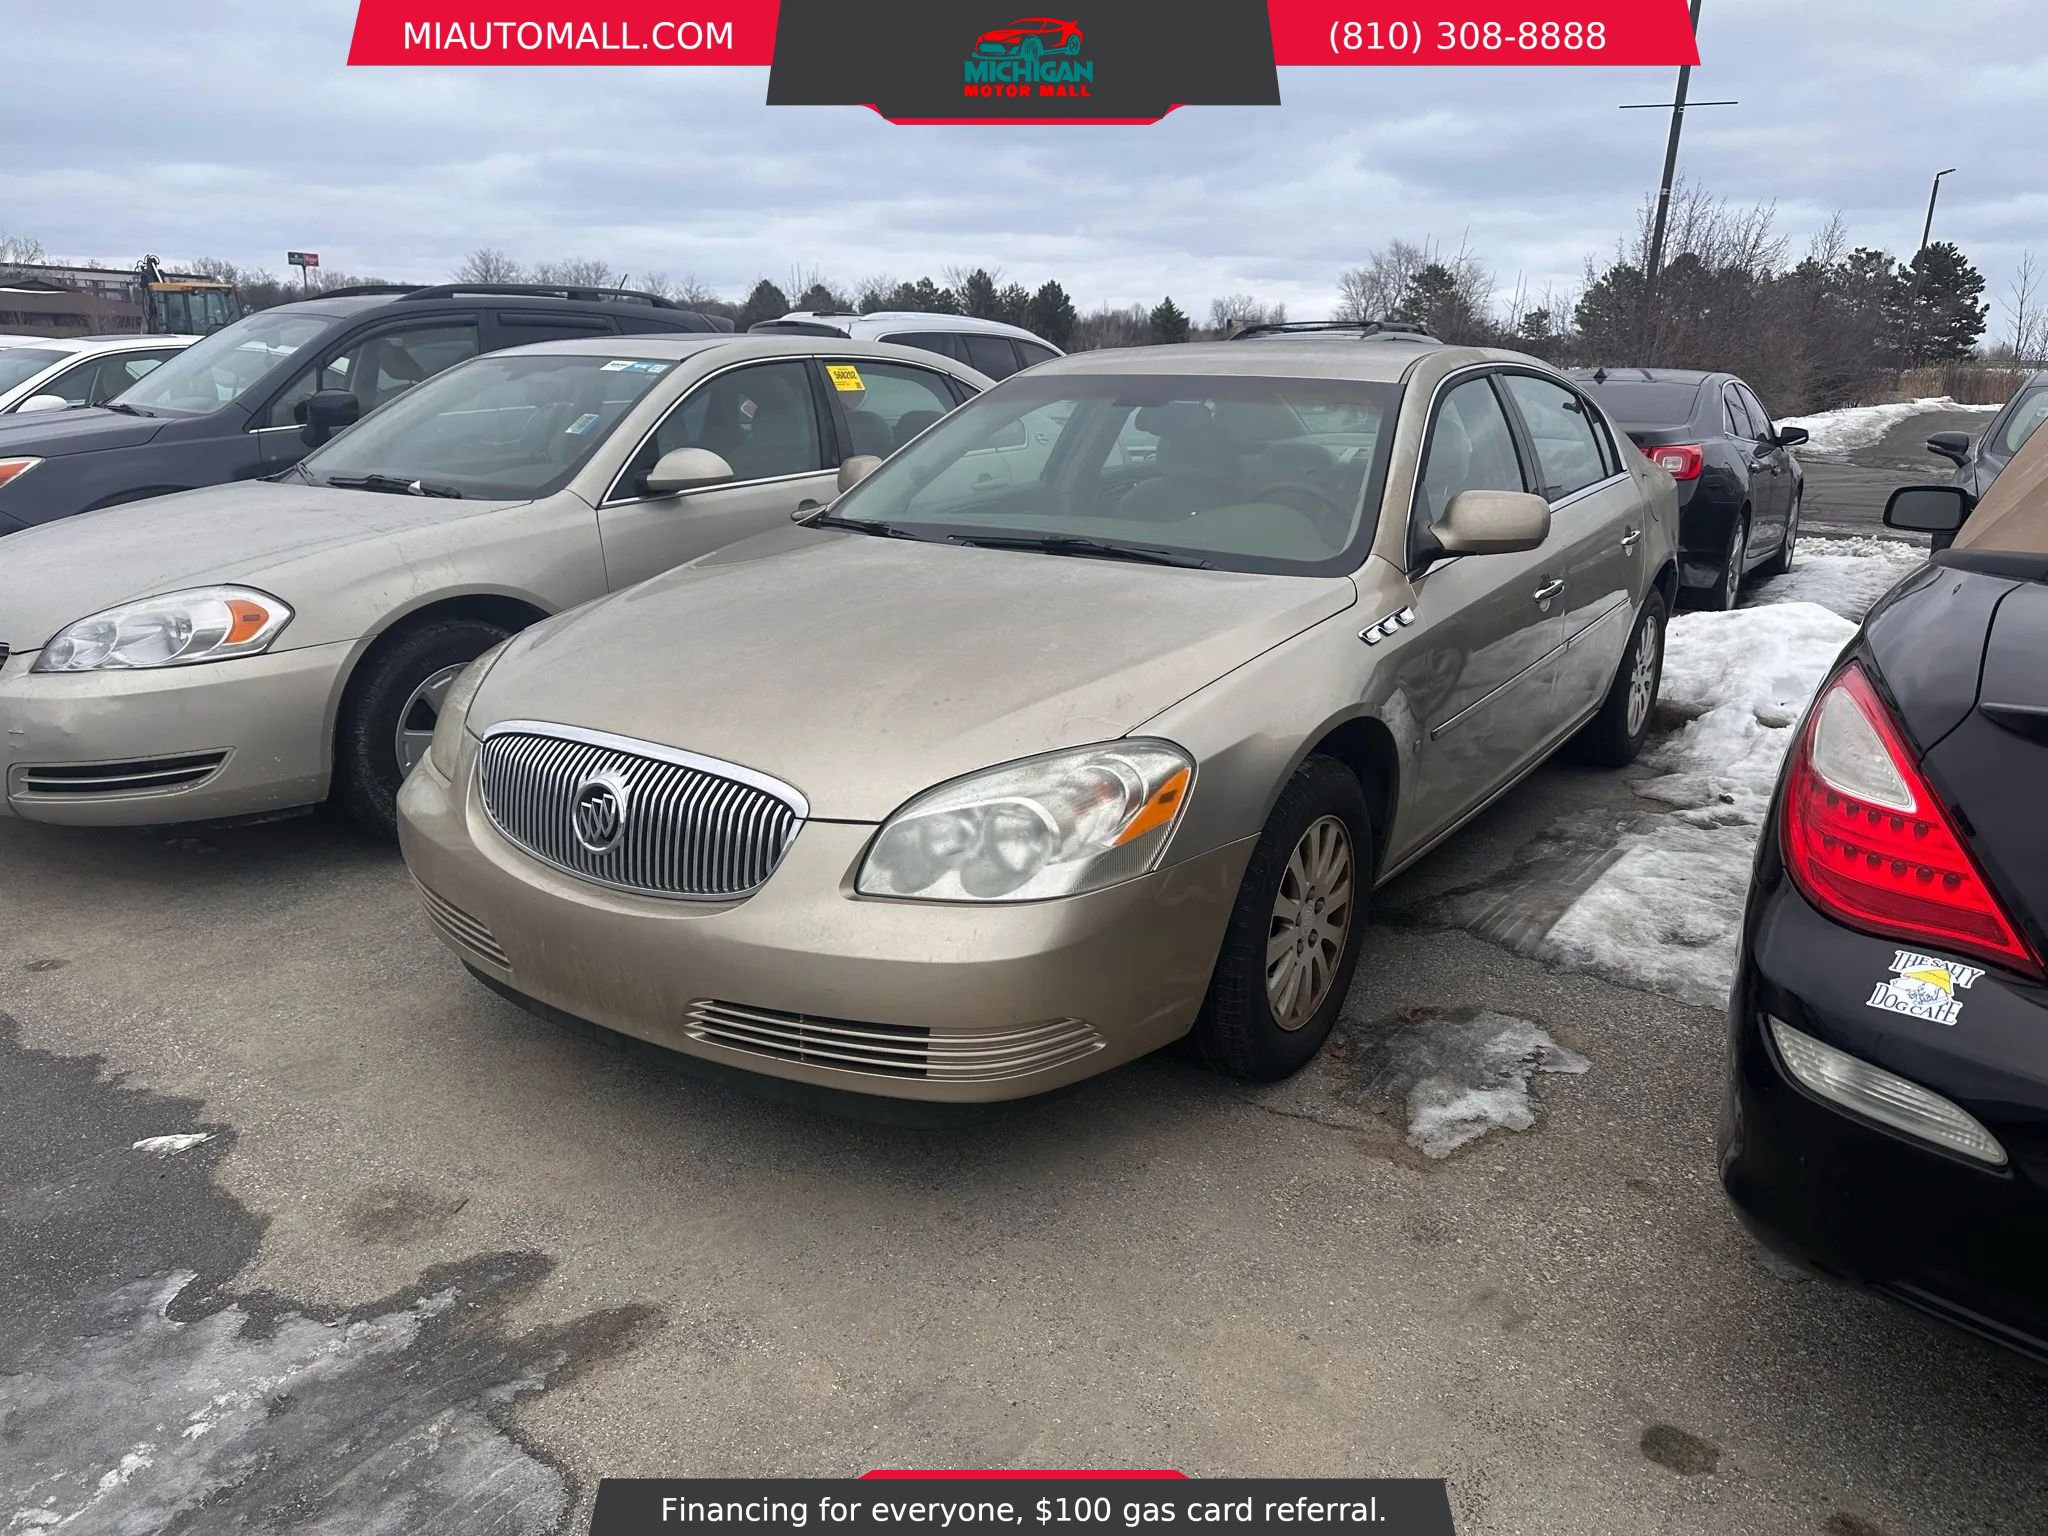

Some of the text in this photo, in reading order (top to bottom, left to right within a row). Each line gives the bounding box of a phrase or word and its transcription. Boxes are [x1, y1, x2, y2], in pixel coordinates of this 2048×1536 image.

[1890, 951, 1982, 988] THE SALTY
[1870, 983, 1908, 1012] DOG
